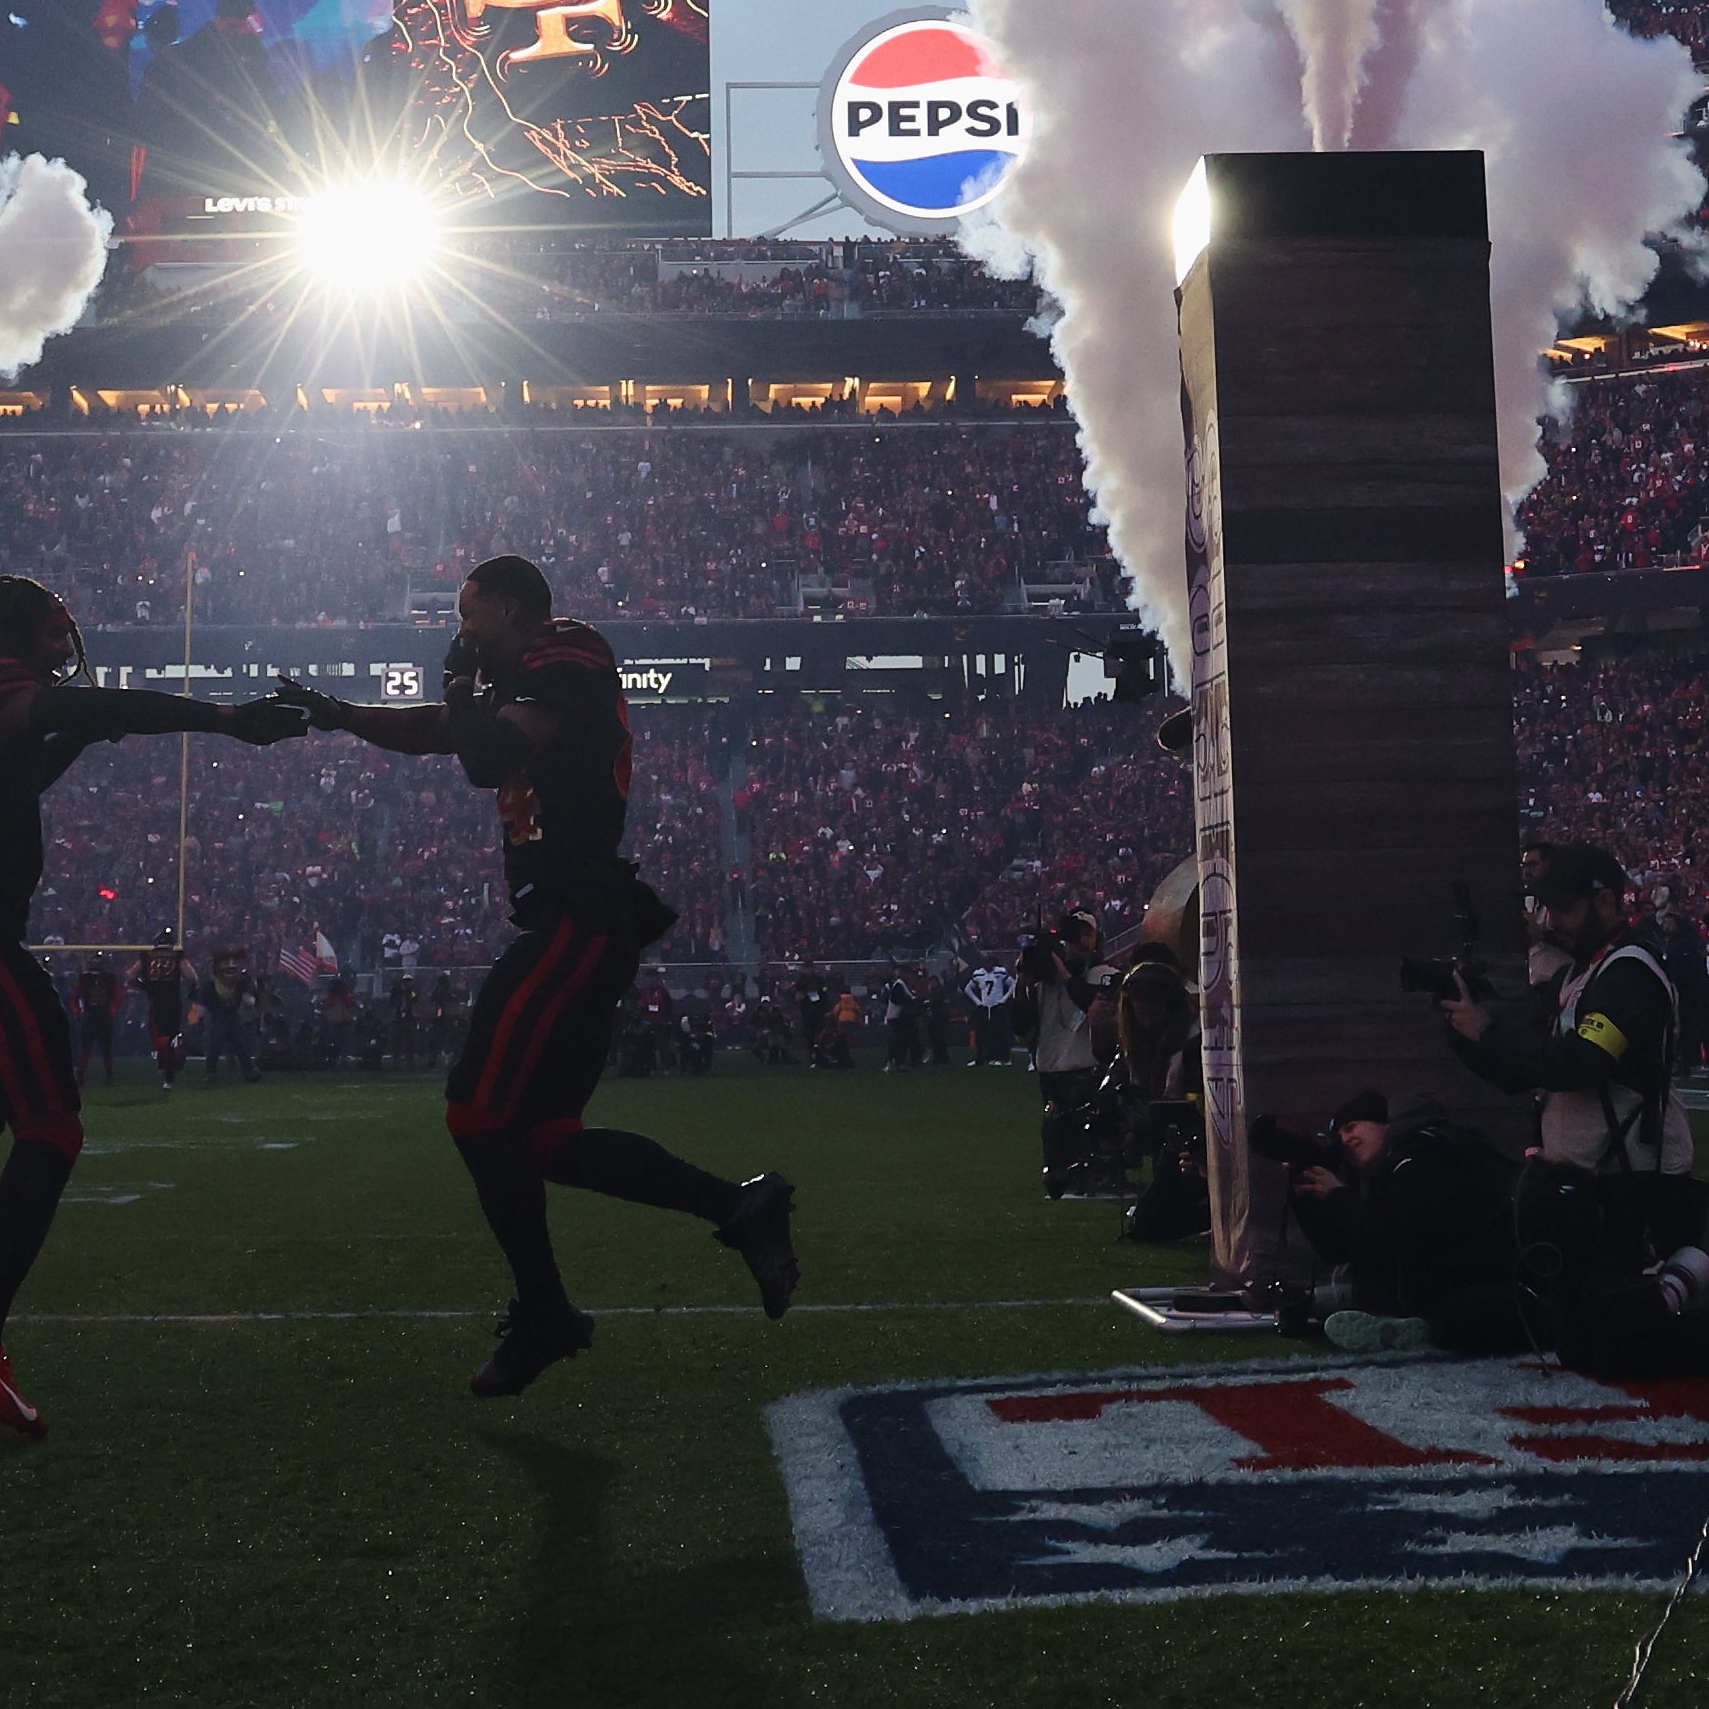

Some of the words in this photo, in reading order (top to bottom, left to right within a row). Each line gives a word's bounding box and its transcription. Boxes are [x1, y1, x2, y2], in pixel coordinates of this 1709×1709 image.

[847, 99, 1020, 138] PEPSI
[386, 671, 419, 696] 25
[616, 667, 673, 695] inity
[984, 980, 994, 996] 7
